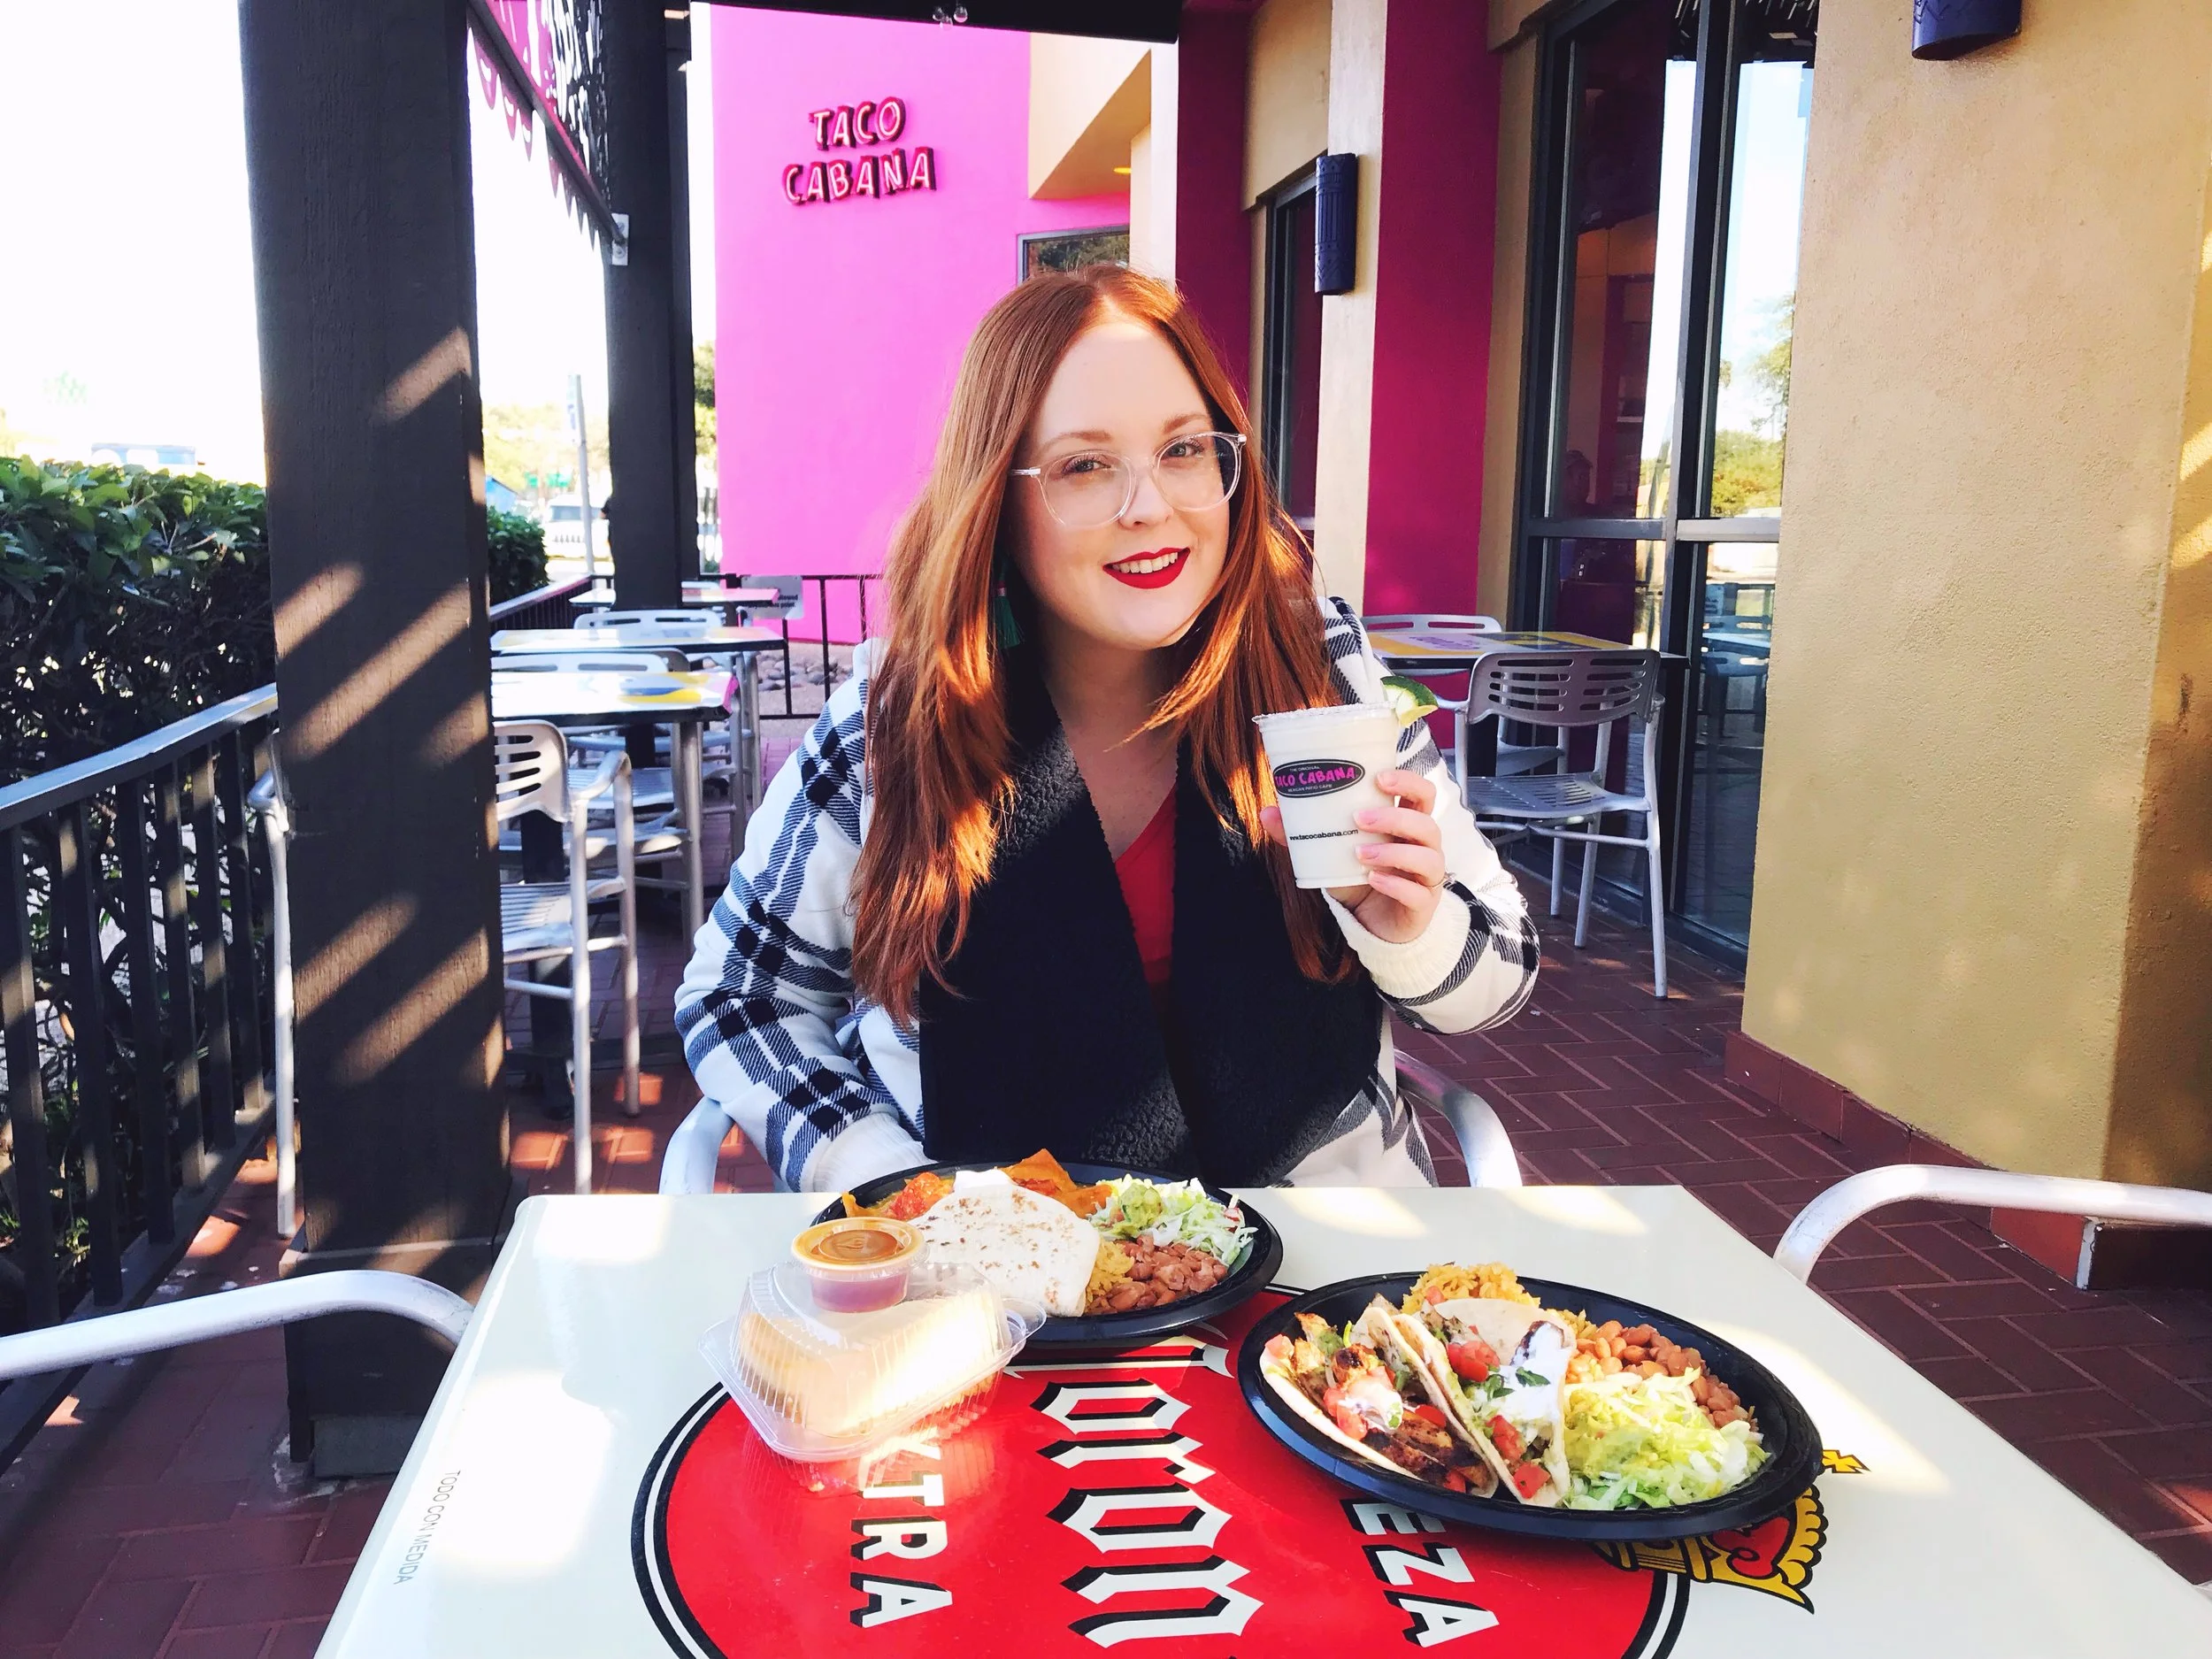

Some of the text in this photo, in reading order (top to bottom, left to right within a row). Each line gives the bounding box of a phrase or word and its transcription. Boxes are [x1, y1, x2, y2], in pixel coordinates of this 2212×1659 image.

[808, 96, 906, 151] TACO
[782, 146, 937, 205] CABANA
[1274, 766, 1356, 787] TACO CABANA
[393, 1470, 461, 1585] TODO CON MEDIDA
[850, 1426, 953, 1628] XTRA
[1340, 1498, 1500, 1647] EZA
